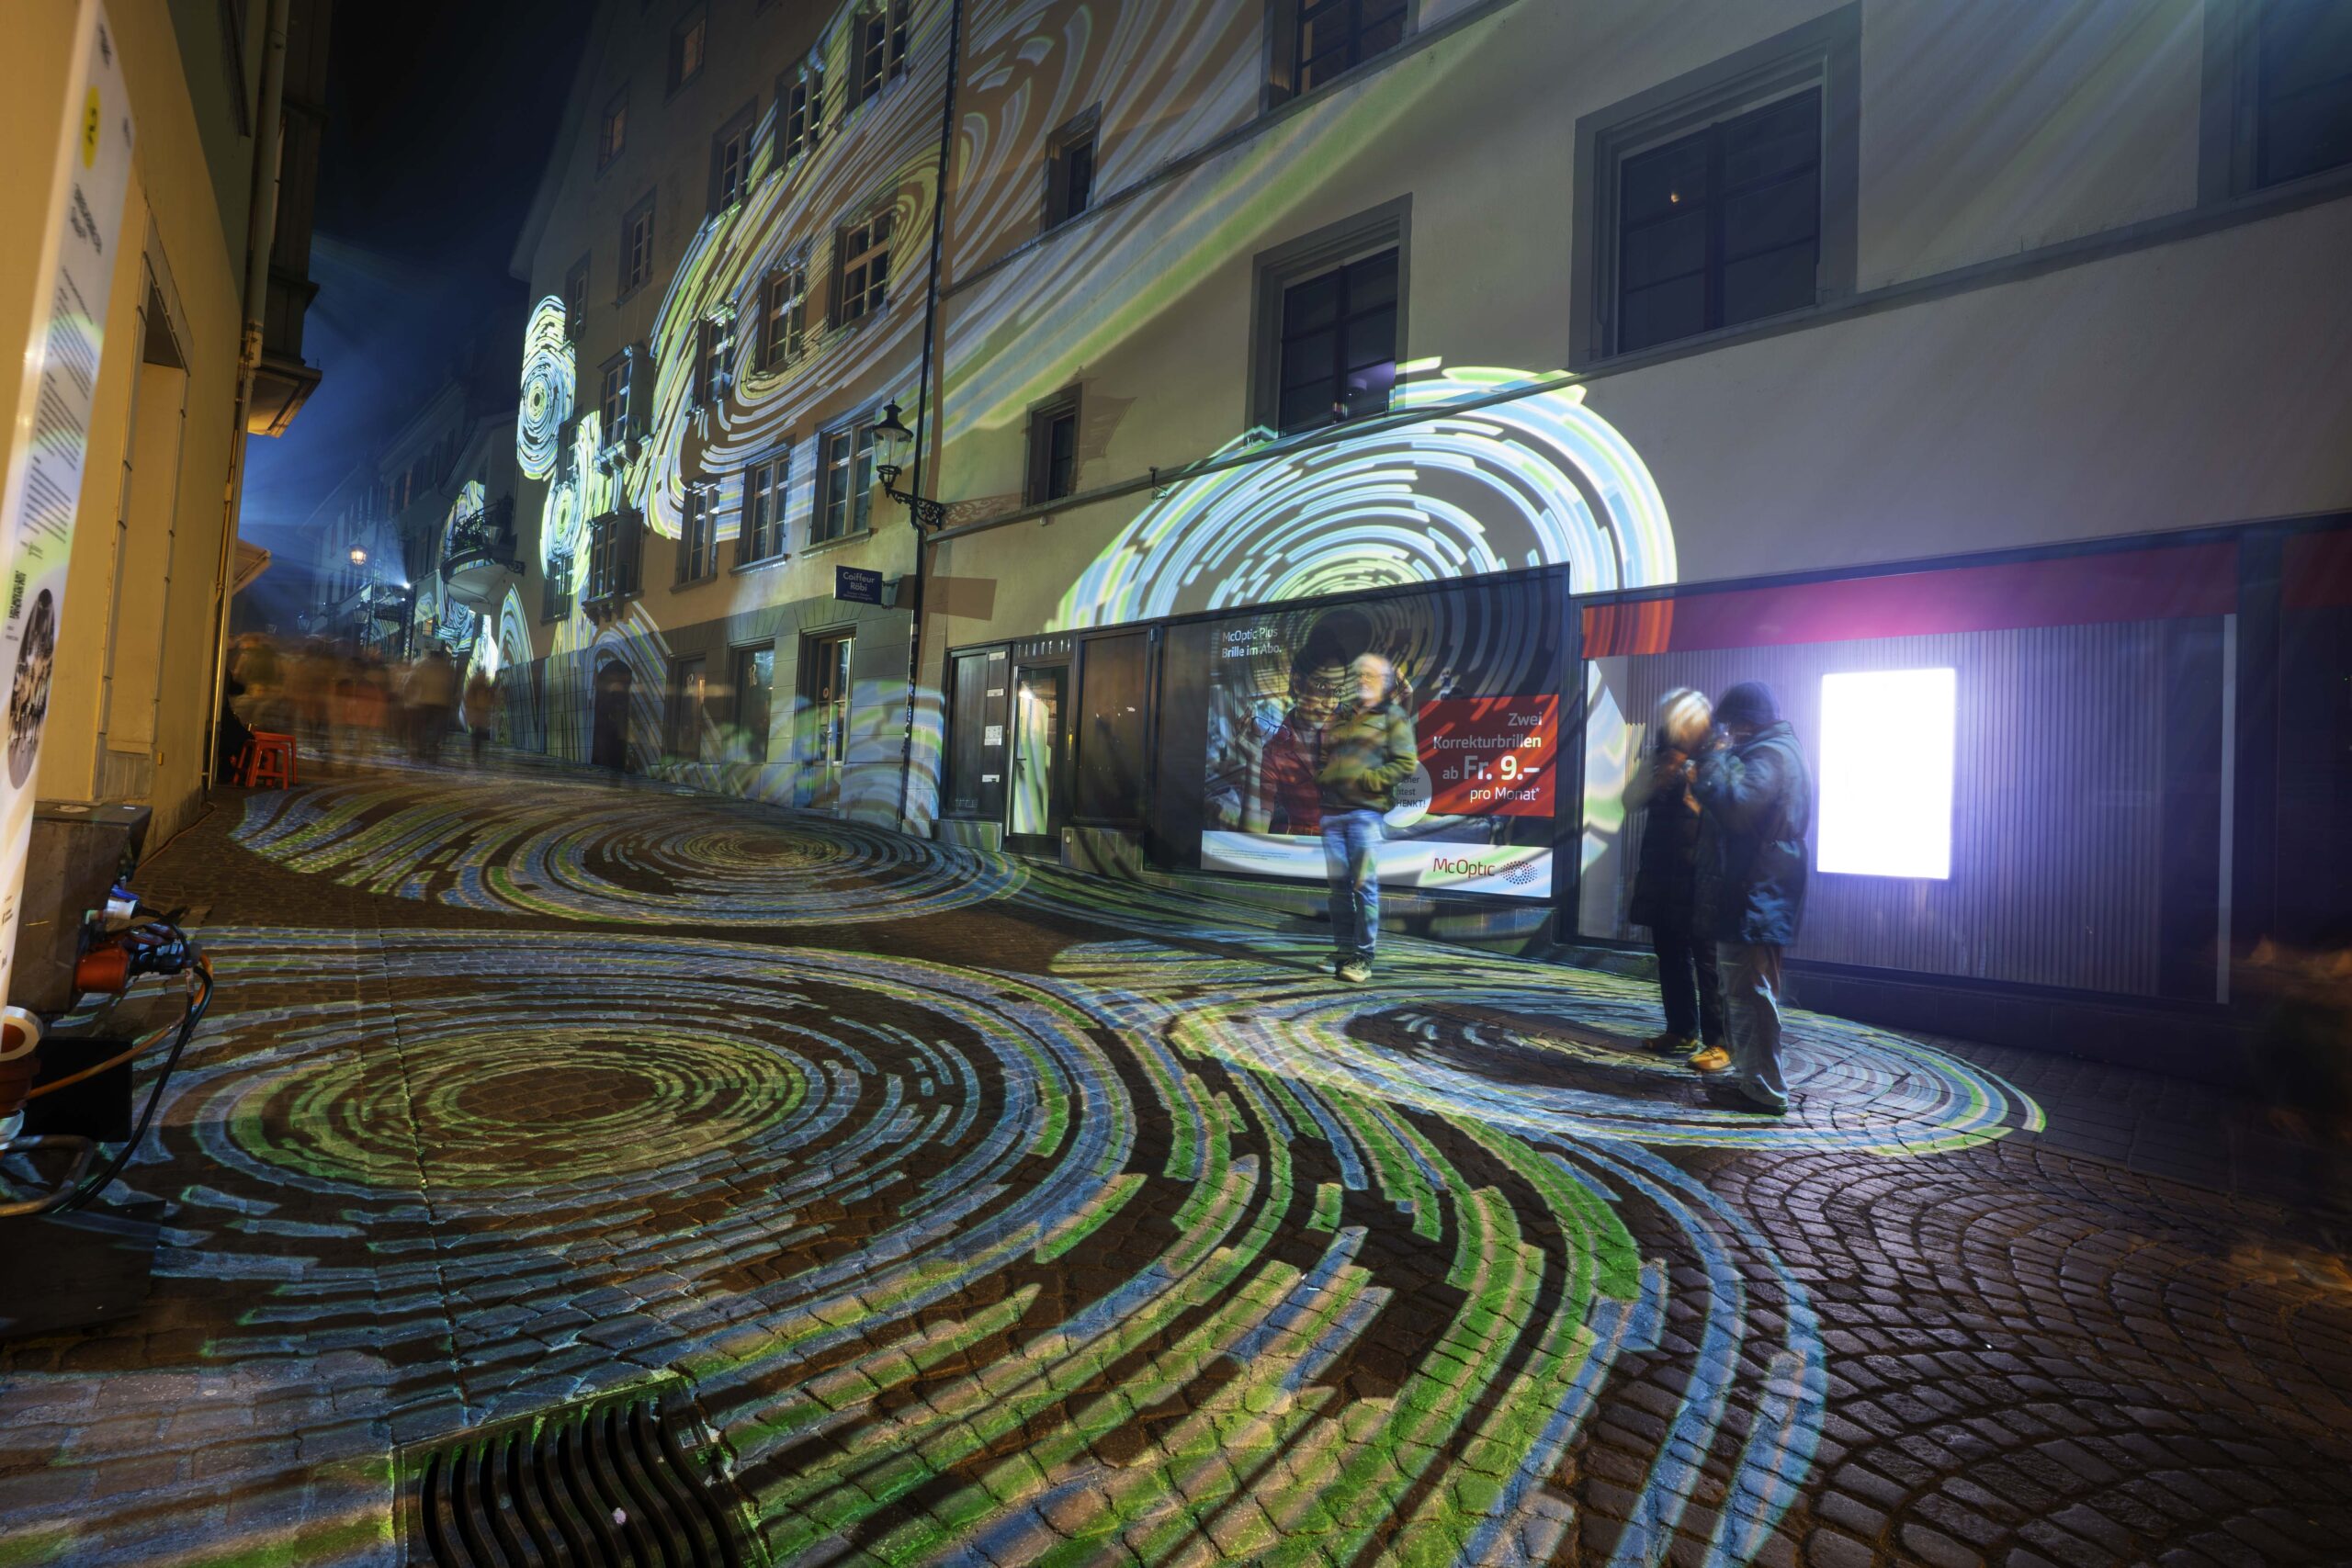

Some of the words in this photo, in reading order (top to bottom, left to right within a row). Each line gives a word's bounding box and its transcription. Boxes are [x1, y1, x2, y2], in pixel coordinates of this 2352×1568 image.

[842, 571, 875, 583] Coiffeur
[850, 581, 867, 592] Röbi
[1222, 628, 1258, 643] McOptic
[1259, 626, 1278, 638] Plus
[1222, 646, 1245, 659] Brille
[1247, 645, 1258, 656] im
[1260, 643, 1283, 655] Abo.
[1508, 712, 1543, 727] Zwei
[1433, 734, 1542, 750] Korrekturbrillen
[1442, 766, 1459, 780] ab
[1464, 755, 1492, 781] Fr.
[1396, 799, 1426, 808] HENKT!
[1470, 790, 1491, 803] pro
[1433, 857, 1495, 878] McOptic
